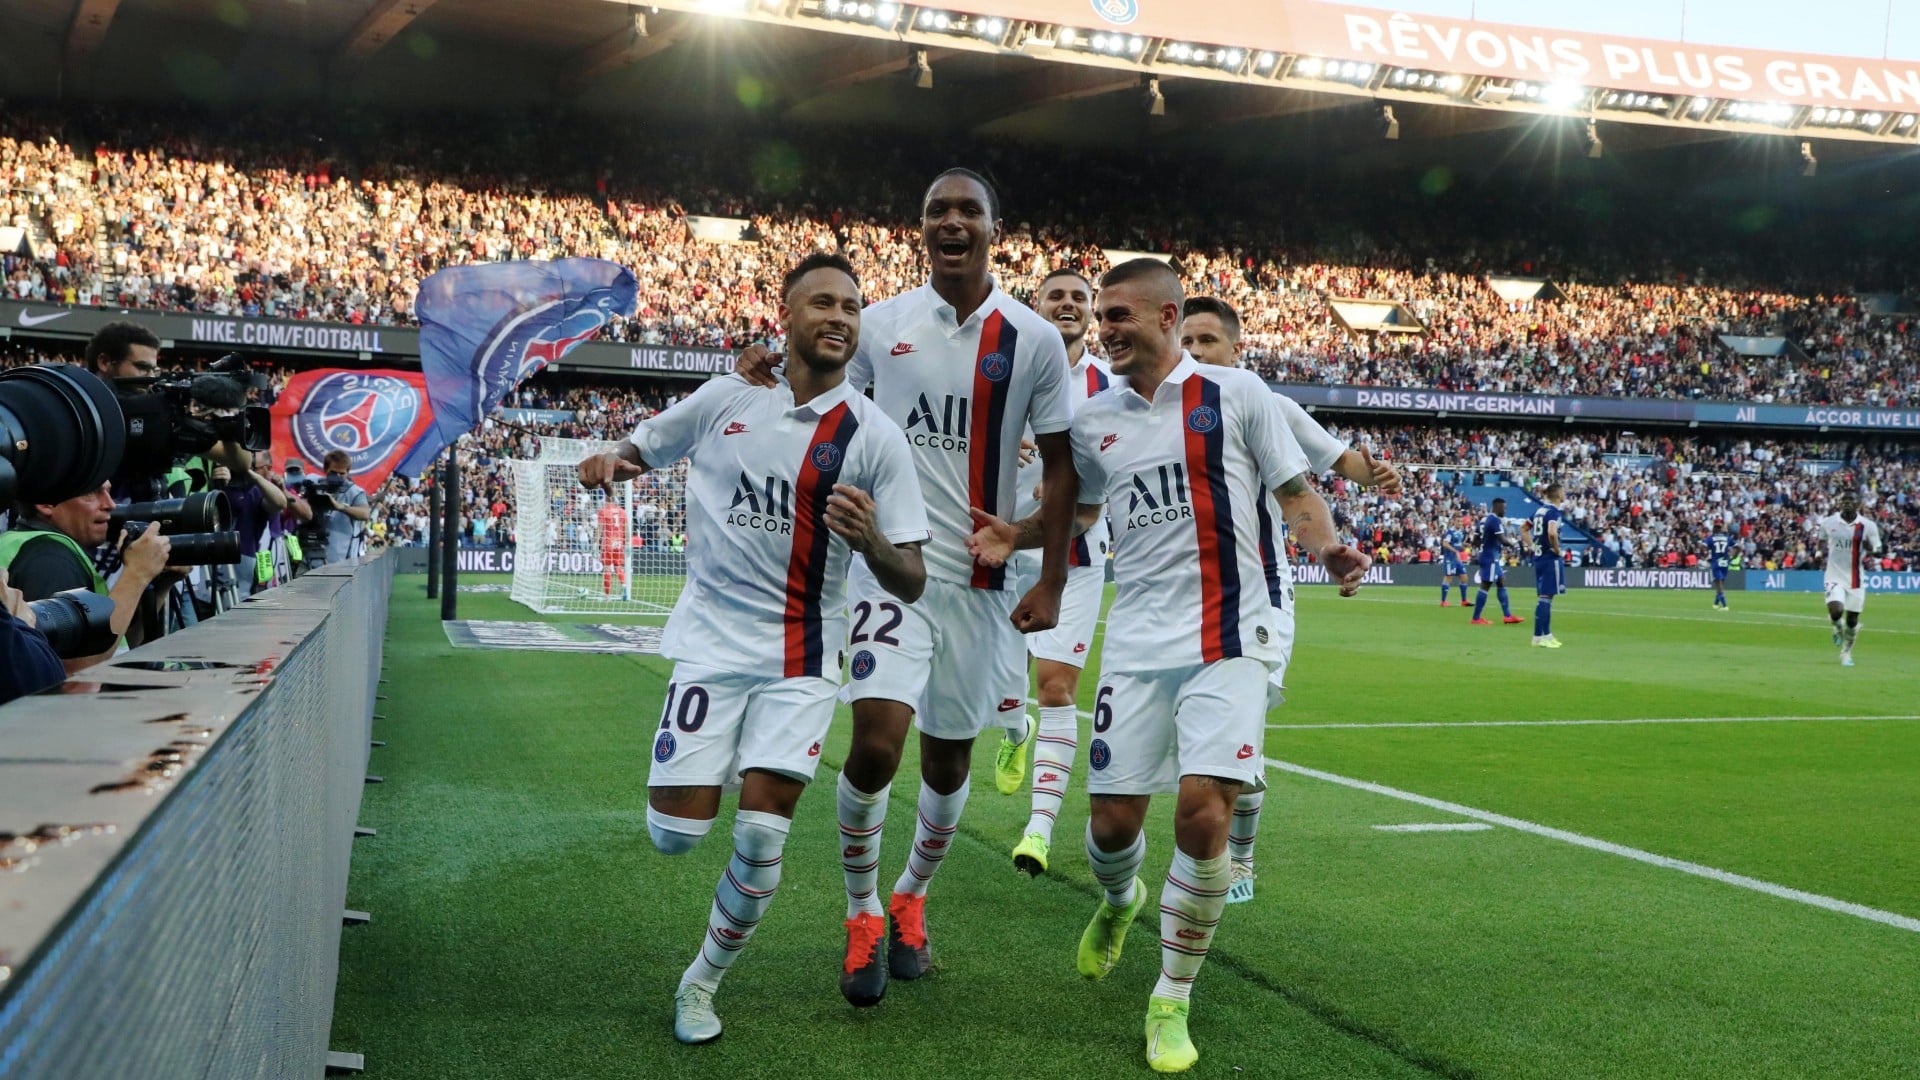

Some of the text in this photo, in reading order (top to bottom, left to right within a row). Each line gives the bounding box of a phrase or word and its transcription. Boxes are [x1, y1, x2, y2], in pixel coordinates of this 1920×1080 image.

[1343, 12, 1920, 104] RÊVONS PLUS GRAN
[192, 319, 383, 352] NIKE.COM/FOOTBALL
[631, 349, 738, 373] NIKE.COM/FO
[1357, 391, 1555, 414] PARIS SAINT-GERMAIN
[1805, 408, 1861, 425] ACCOR
[1867, 411, 1902, 426] LIVE
[727, 512, 791, 536] ACCOR
[1127, 505, 1193, 531] ACCOR
[1533, 516, 1544, 535] 13
[1713, 541, 1728, 553] 17
[1585, 569, 1712, 588] NIKE.COM/FOOTBALL
[1863, 575, 1892, 589] COR
[850, 600, 903, 647] 22
[660, 682, 710, 733] 10
[1094, 686, 1114, 733] 6
